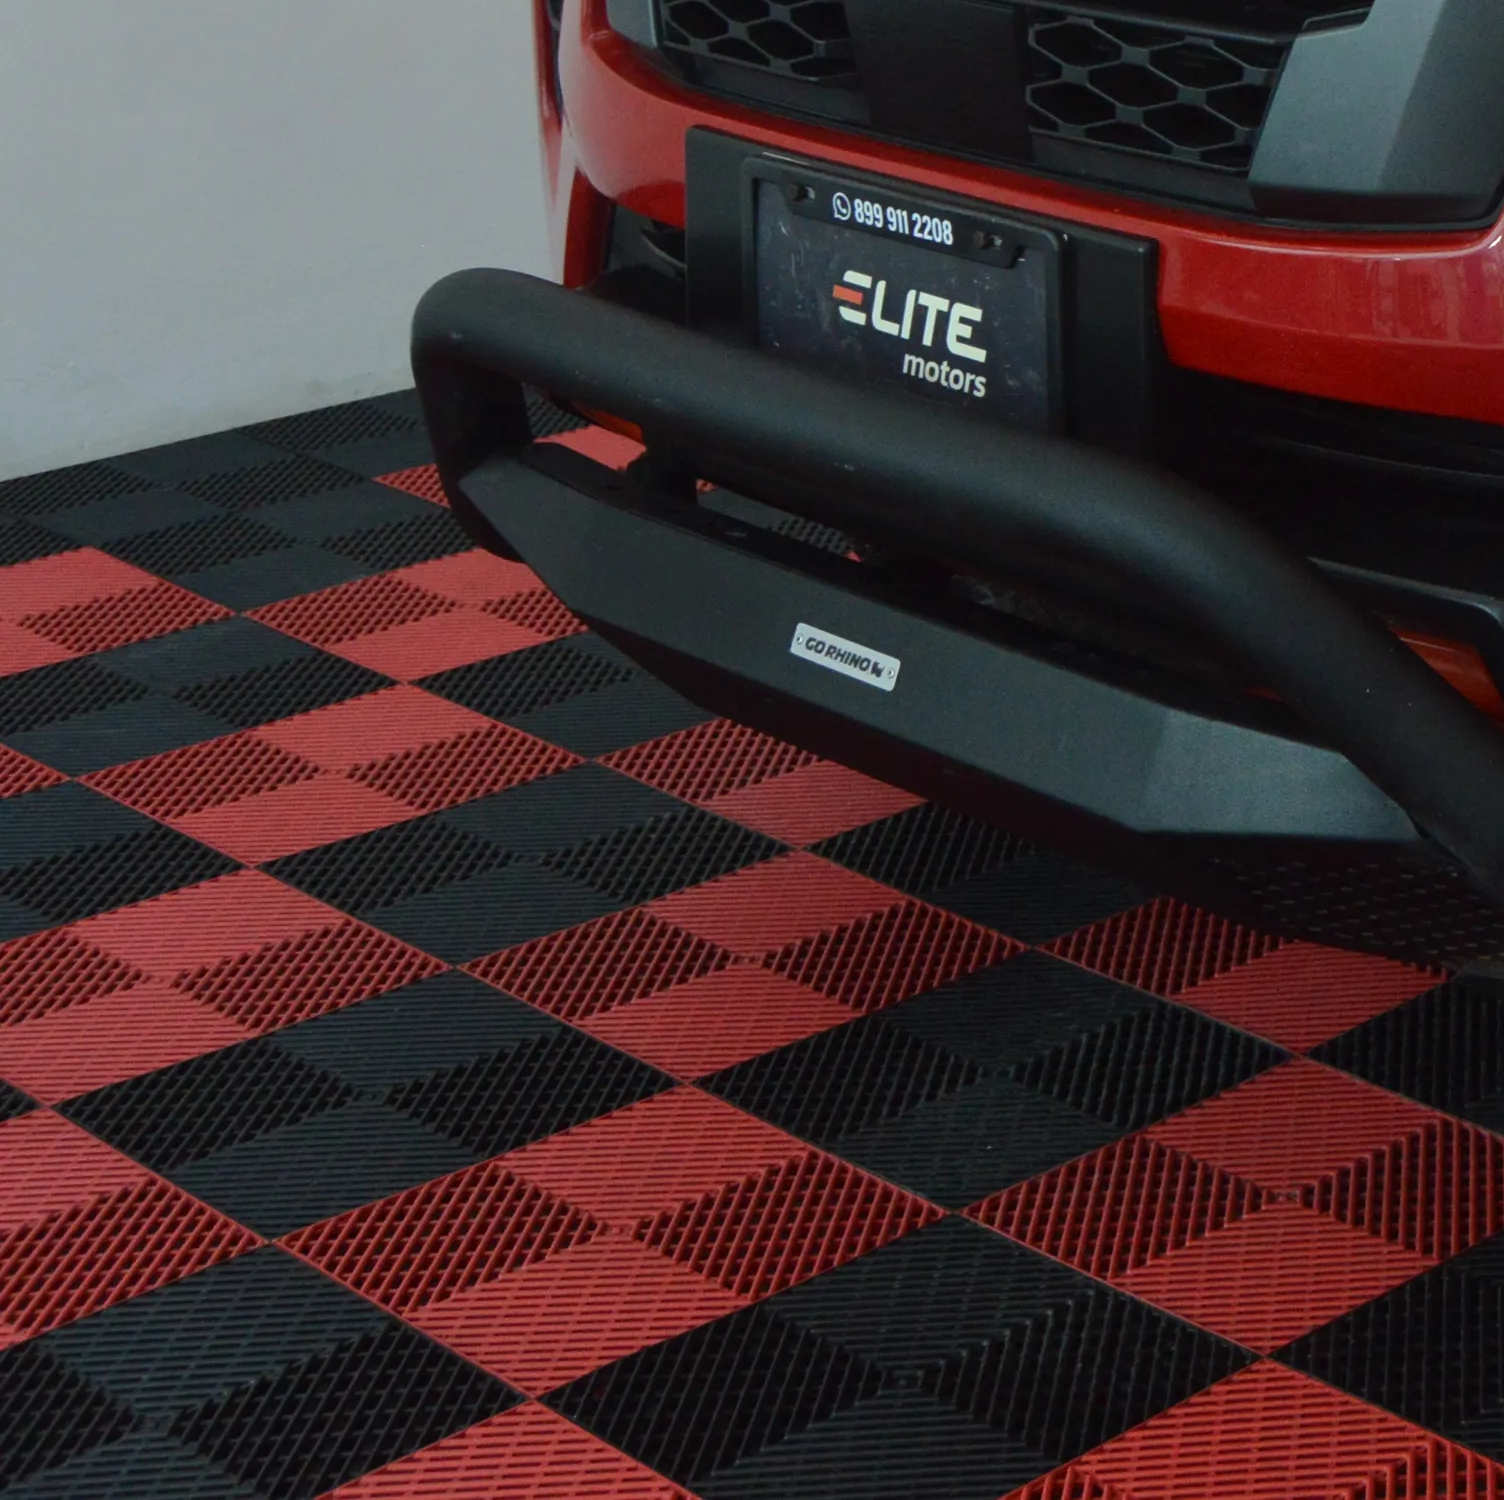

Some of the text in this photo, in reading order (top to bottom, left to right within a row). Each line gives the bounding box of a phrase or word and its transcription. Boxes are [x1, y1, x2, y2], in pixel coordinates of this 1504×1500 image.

[853, 198, 954, 246] 899 911 2208
[832, 269, 987, 364] ELITE
[902, 353, 987, 398] motors
